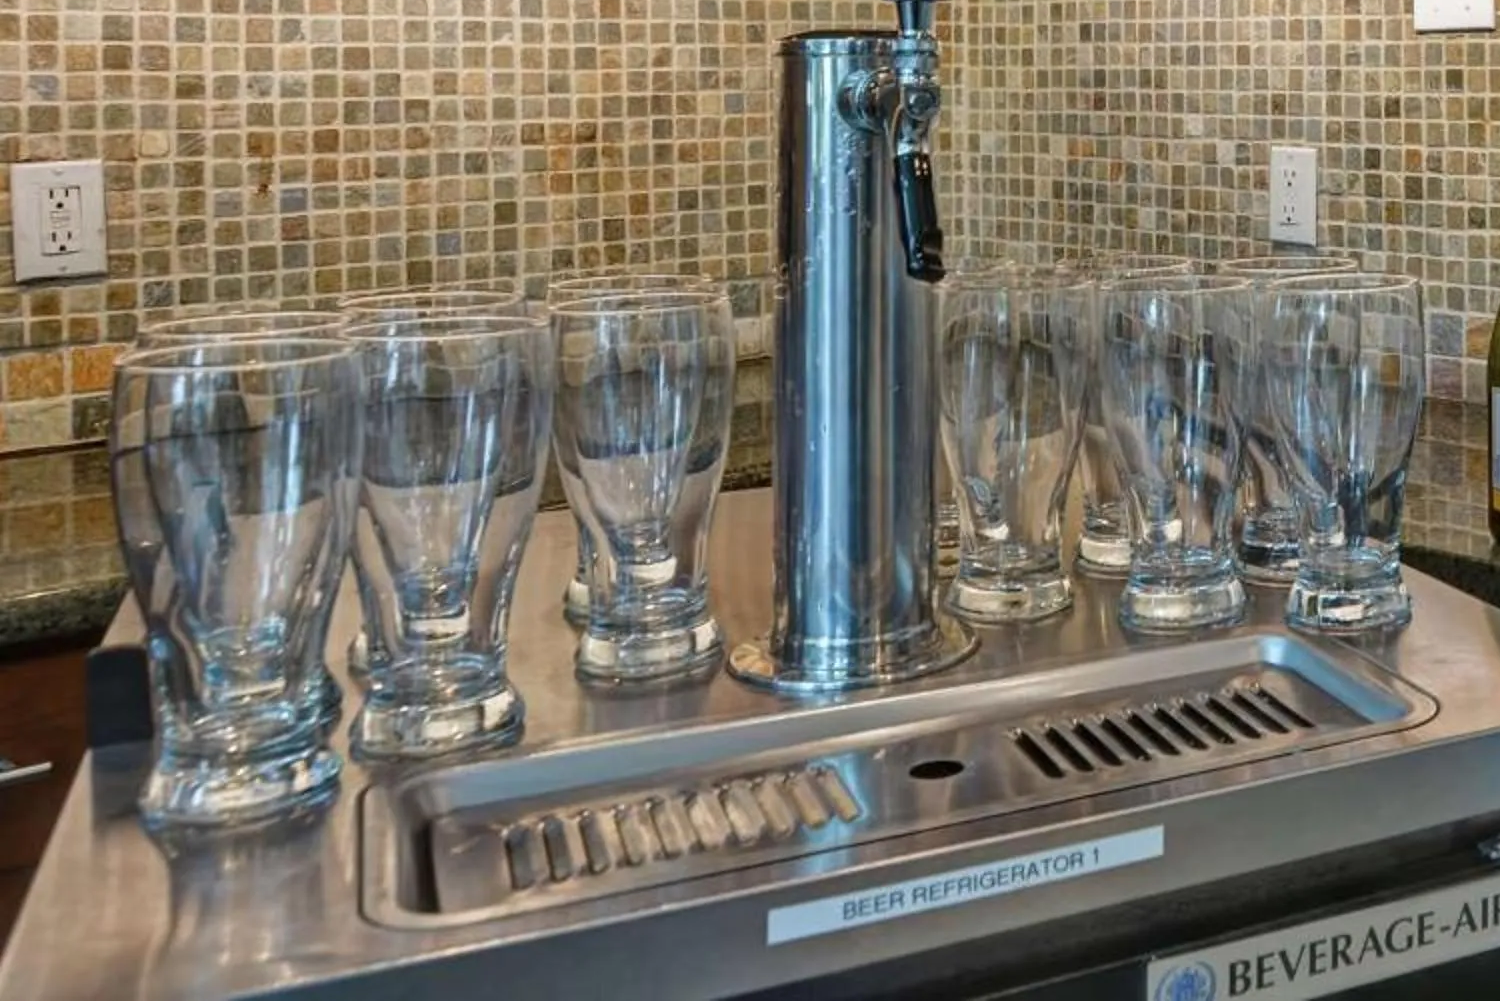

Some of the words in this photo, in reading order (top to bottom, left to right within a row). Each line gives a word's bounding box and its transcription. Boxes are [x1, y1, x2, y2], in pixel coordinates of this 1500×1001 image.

[842, 892, 906, 921] BEER
[911, 853, 1085, 904] REFRIGERATOR
[1092, 847, 1100, 864] 1
